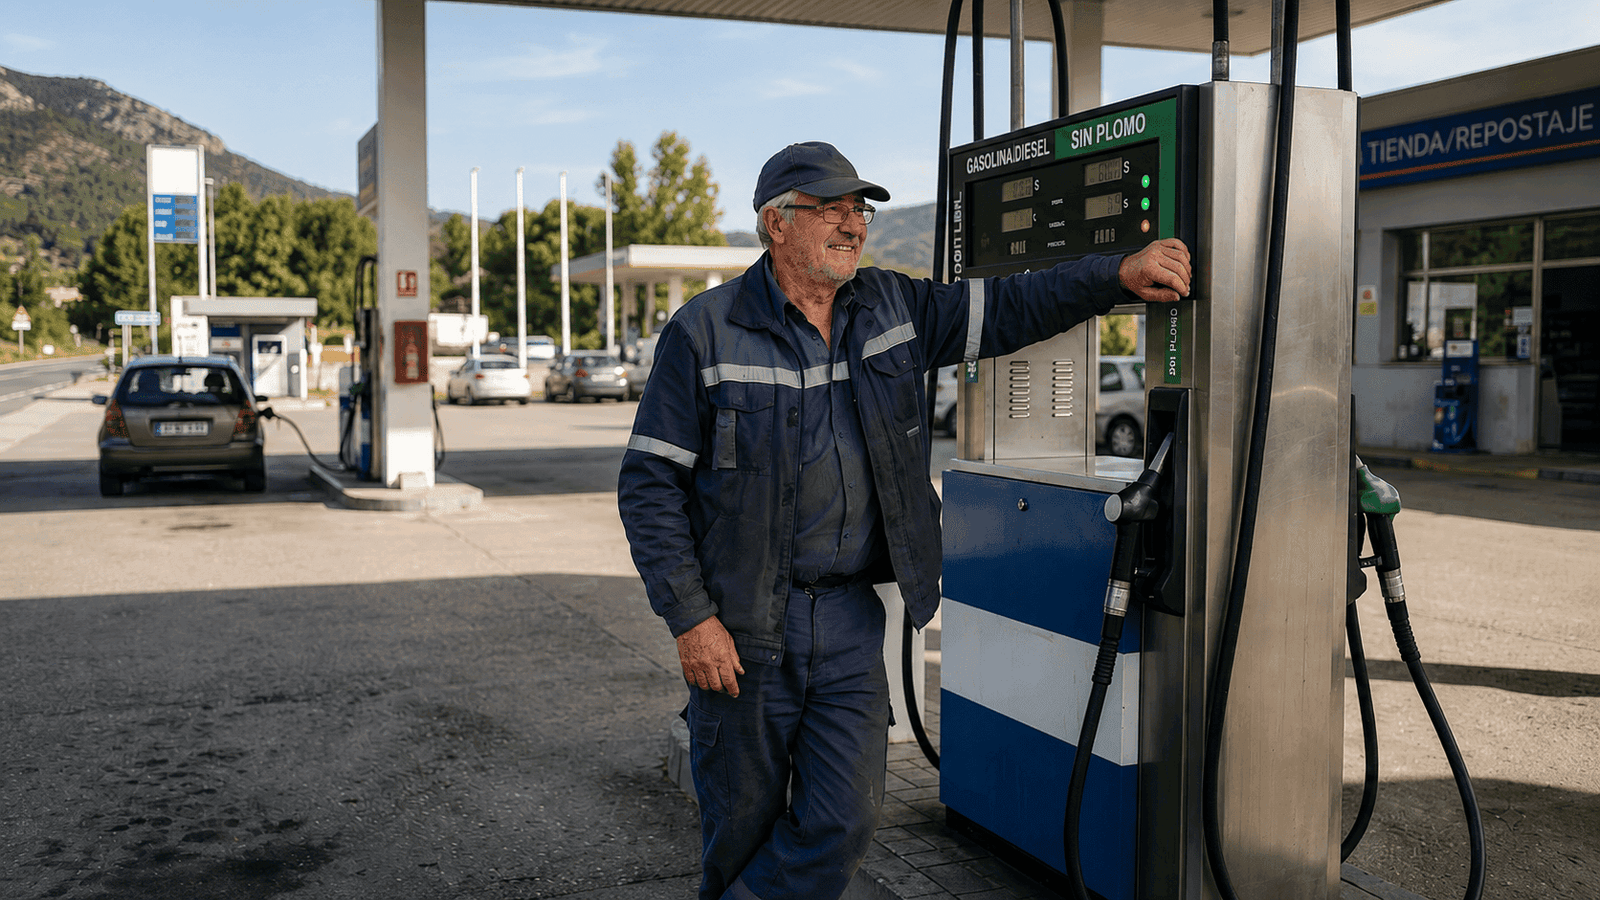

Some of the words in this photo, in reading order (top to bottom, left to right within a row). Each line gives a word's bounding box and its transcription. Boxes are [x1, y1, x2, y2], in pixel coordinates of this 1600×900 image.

[1071, 126, 1092, 150] SIN
[1096, 113, 1146, 145] PLOMO
[1367, 103, 1594, 165] TIENDA/REPOSTAJE
